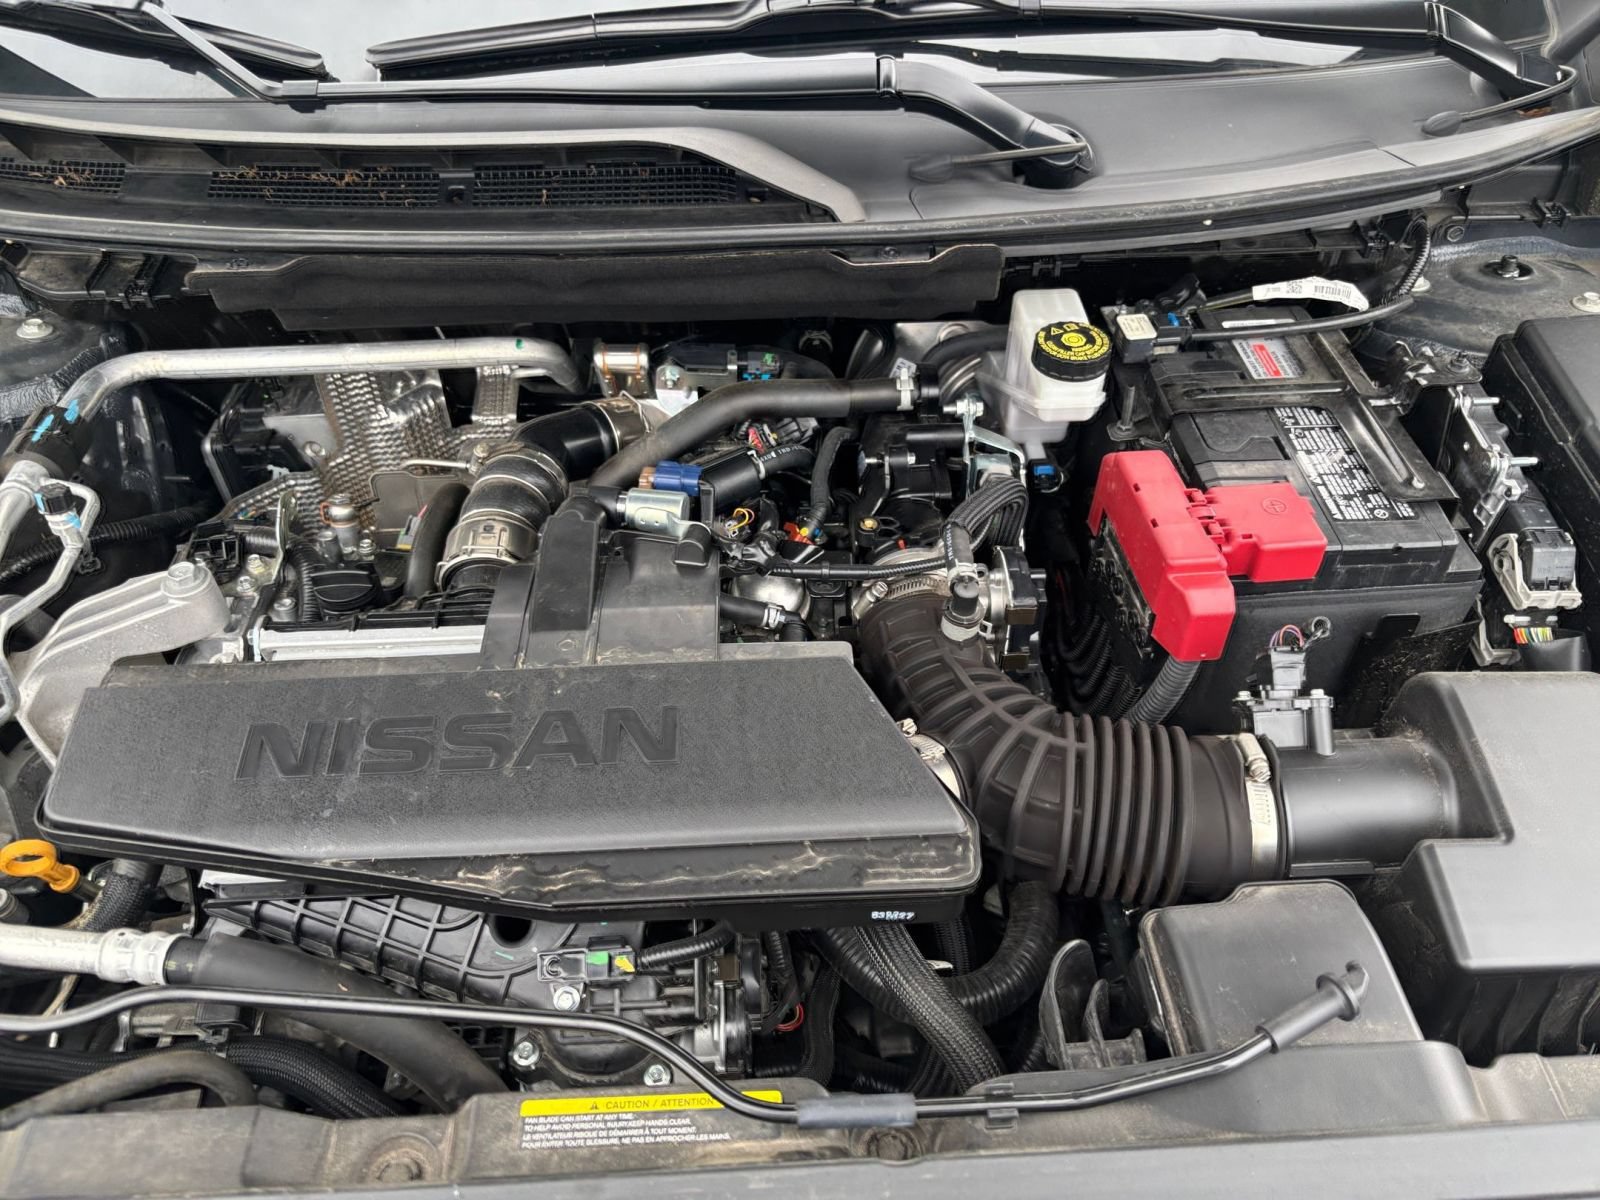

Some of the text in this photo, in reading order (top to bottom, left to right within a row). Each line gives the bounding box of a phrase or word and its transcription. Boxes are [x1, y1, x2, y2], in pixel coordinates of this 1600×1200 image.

[234, 706, 680, 781] NISSAN
[605, 1100, 649, 1110] CAUTION
[660, 1098, 714, 1107] ATTENTION
